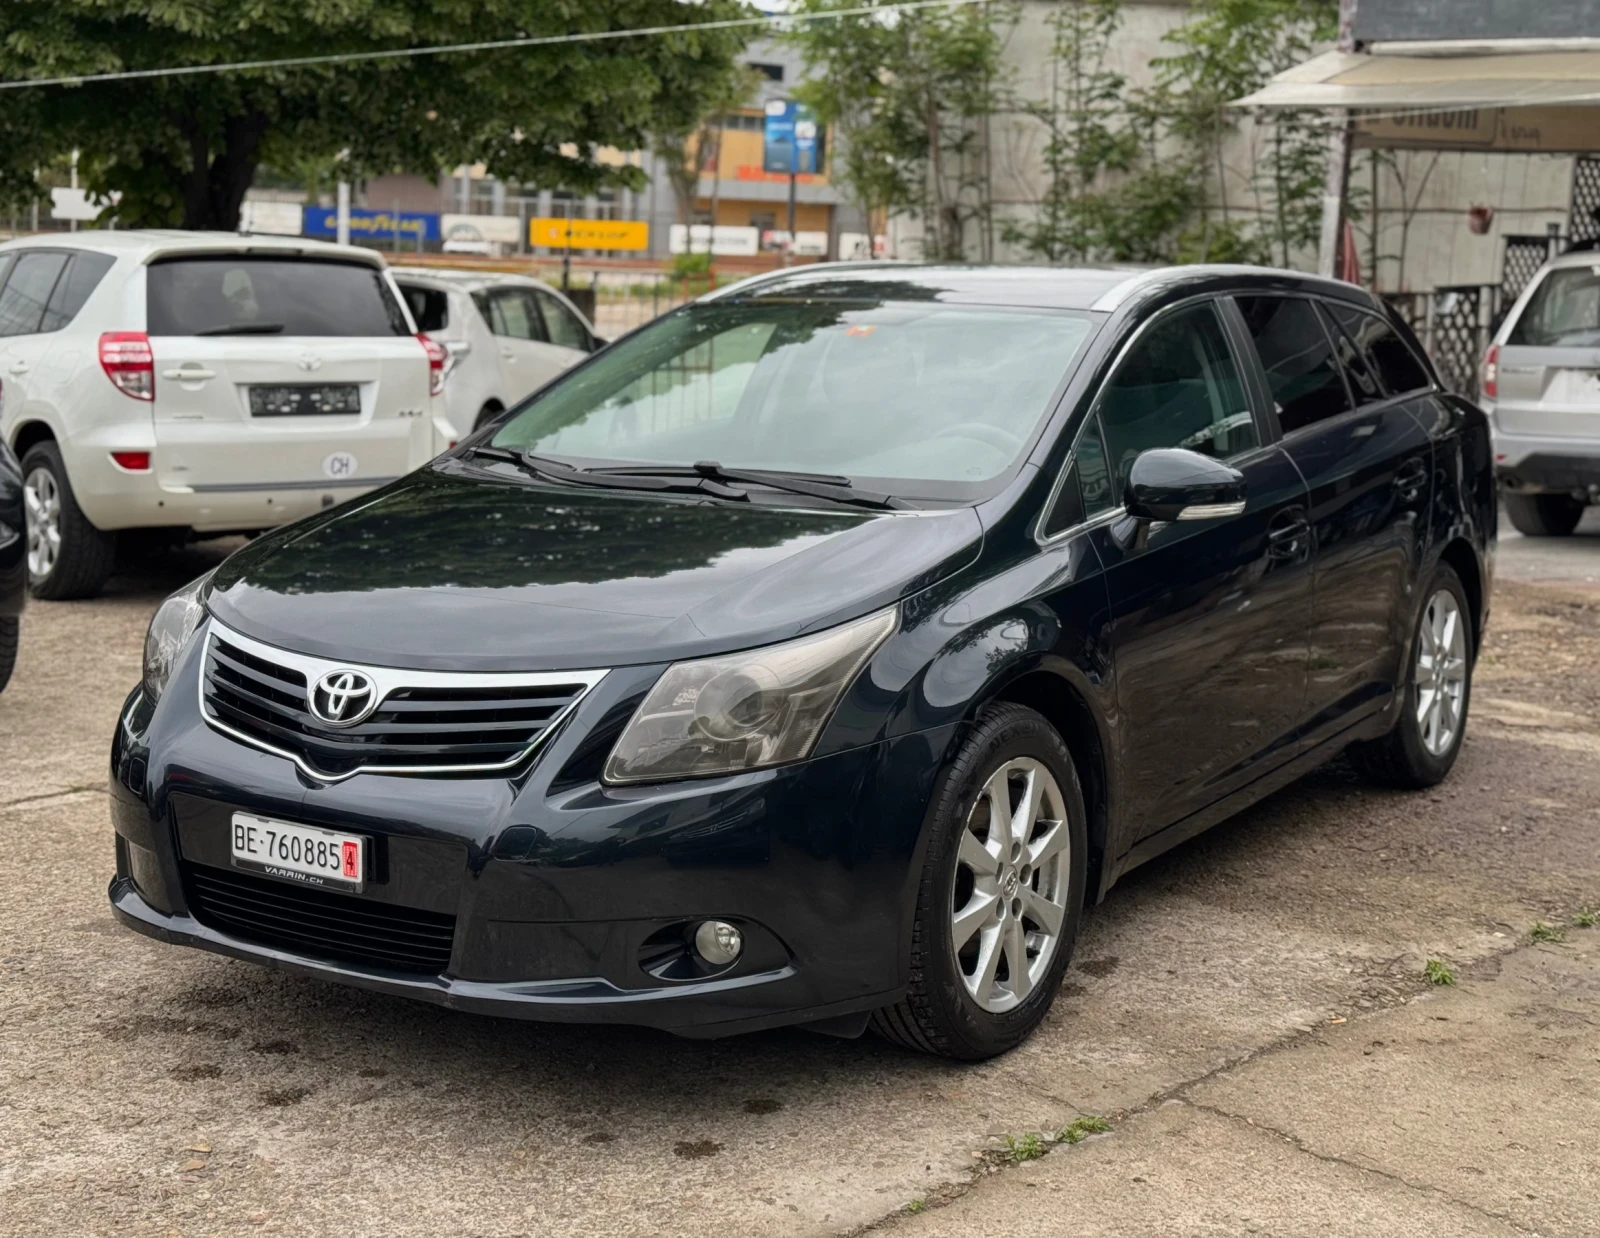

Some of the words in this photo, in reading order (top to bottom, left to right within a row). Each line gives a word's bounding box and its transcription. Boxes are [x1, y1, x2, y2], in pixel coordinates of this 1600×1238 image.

[331, 456, 350, 475] CH
[346, 851, 354, 870] 4
[264, 865, 324, 885] VARRIN.CH
